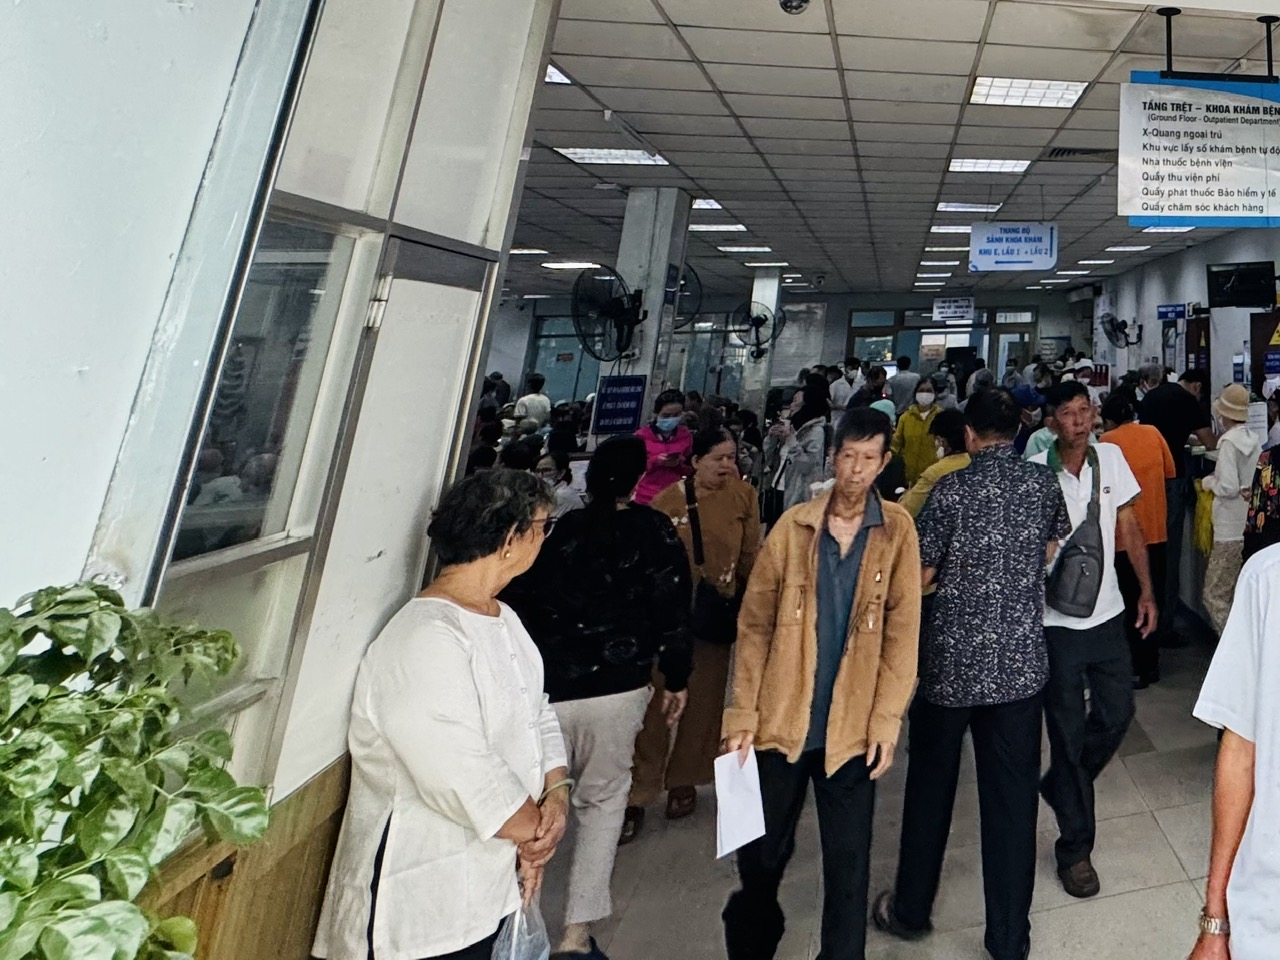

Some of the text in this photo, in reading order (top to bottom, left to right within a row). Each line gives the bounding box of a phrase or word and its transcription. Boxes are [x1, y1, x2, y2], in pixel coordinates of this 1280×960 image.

[1170, 101, 1193, 114] TRỆT
[1205, 104, 1231, 114] KHOA
[1233, 104, 1260, 115] KHÁM
[1147, 113, 1177, 122] (Ground
[1179, 114, 1197, 122] Floor
[1203, 115, 1239, 124] Outpatient
[1142, 128, 1208, 140] X-Quang ngoại
[1142, 142, 1161, 151] Khu
[1163, 143, 1179, 153] vực
[1181, 143, 1194, 154] lấy
[1196, 143, 1208, 153] số
[1209, 144, 1233, 153] khám
[1235, 145, 1257, 155] bệnh
[1162, 157, 1187, 166] thuốc
[1190, 158, 1212, 168] bệnh
[1214, 159, 1233, 169] viện
[1168, 172, 1183, 181] thu
[1185, 172, 1203, 183] viện
[1190, 187, 1215, 197] thuốc
[1268, 188, 1277, 197] tế
[1213, 203, 1239, 212] khách
